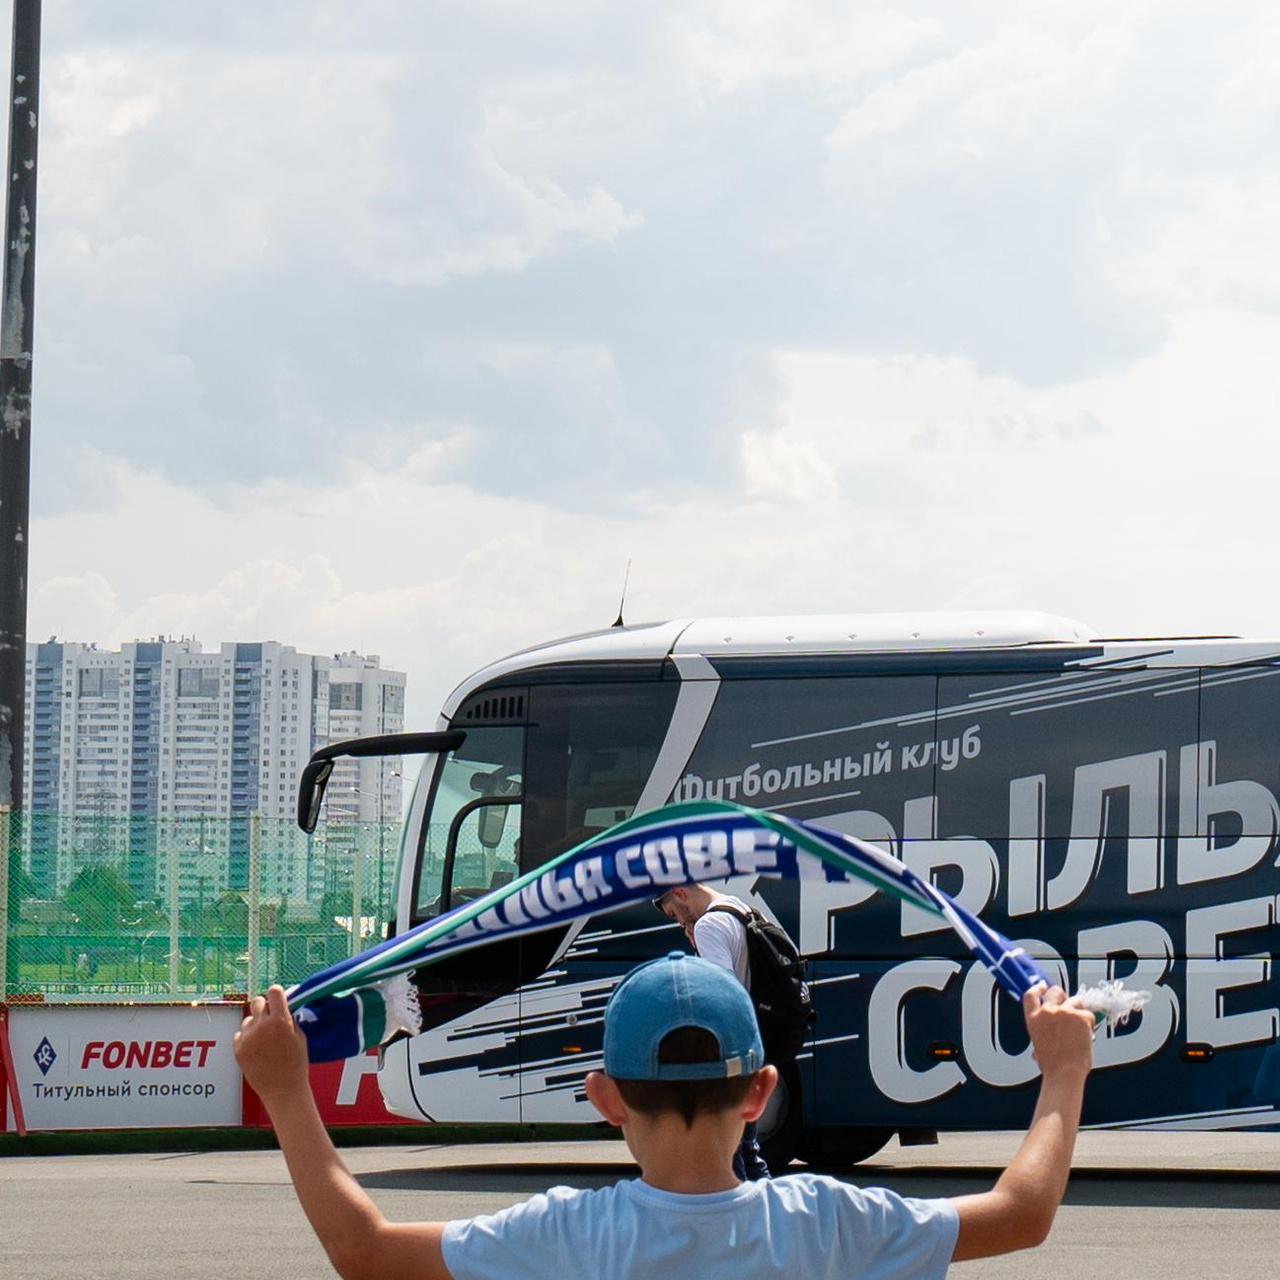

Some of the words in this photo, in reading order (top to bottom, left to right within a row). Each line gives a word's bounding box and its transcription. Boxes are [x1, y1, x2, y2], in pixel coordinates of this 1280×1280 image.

[674, 740, 893, 804] Футбольный
[902, 725, 982, 771] клуб
[81, 1040, 216, 1070] FONBET
[33, 1079, 131, 1101] Титульный
[138, 1081, 215, 1099] спонсор
